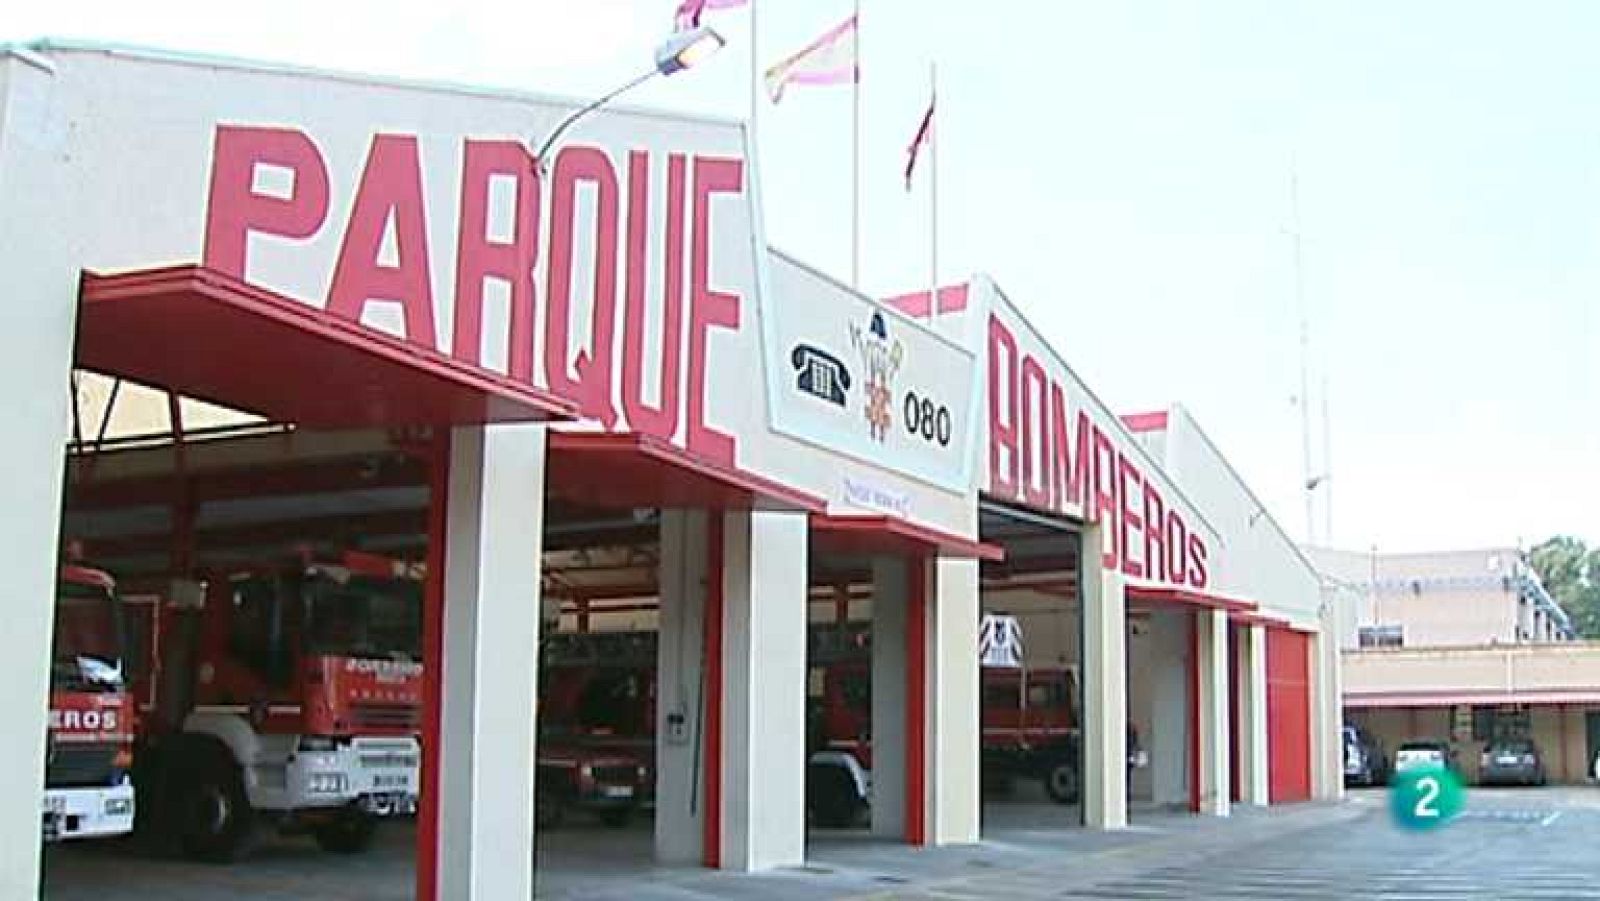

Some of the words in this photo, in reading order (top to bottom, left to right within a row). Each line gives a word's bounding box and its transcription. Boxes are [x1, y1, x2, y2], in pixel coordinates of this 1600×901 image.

[201, 124, 743, 468] PARQUE
[903, 391, 951, 447] 080
[989, 311, 1208, 589] BOMBEROS
